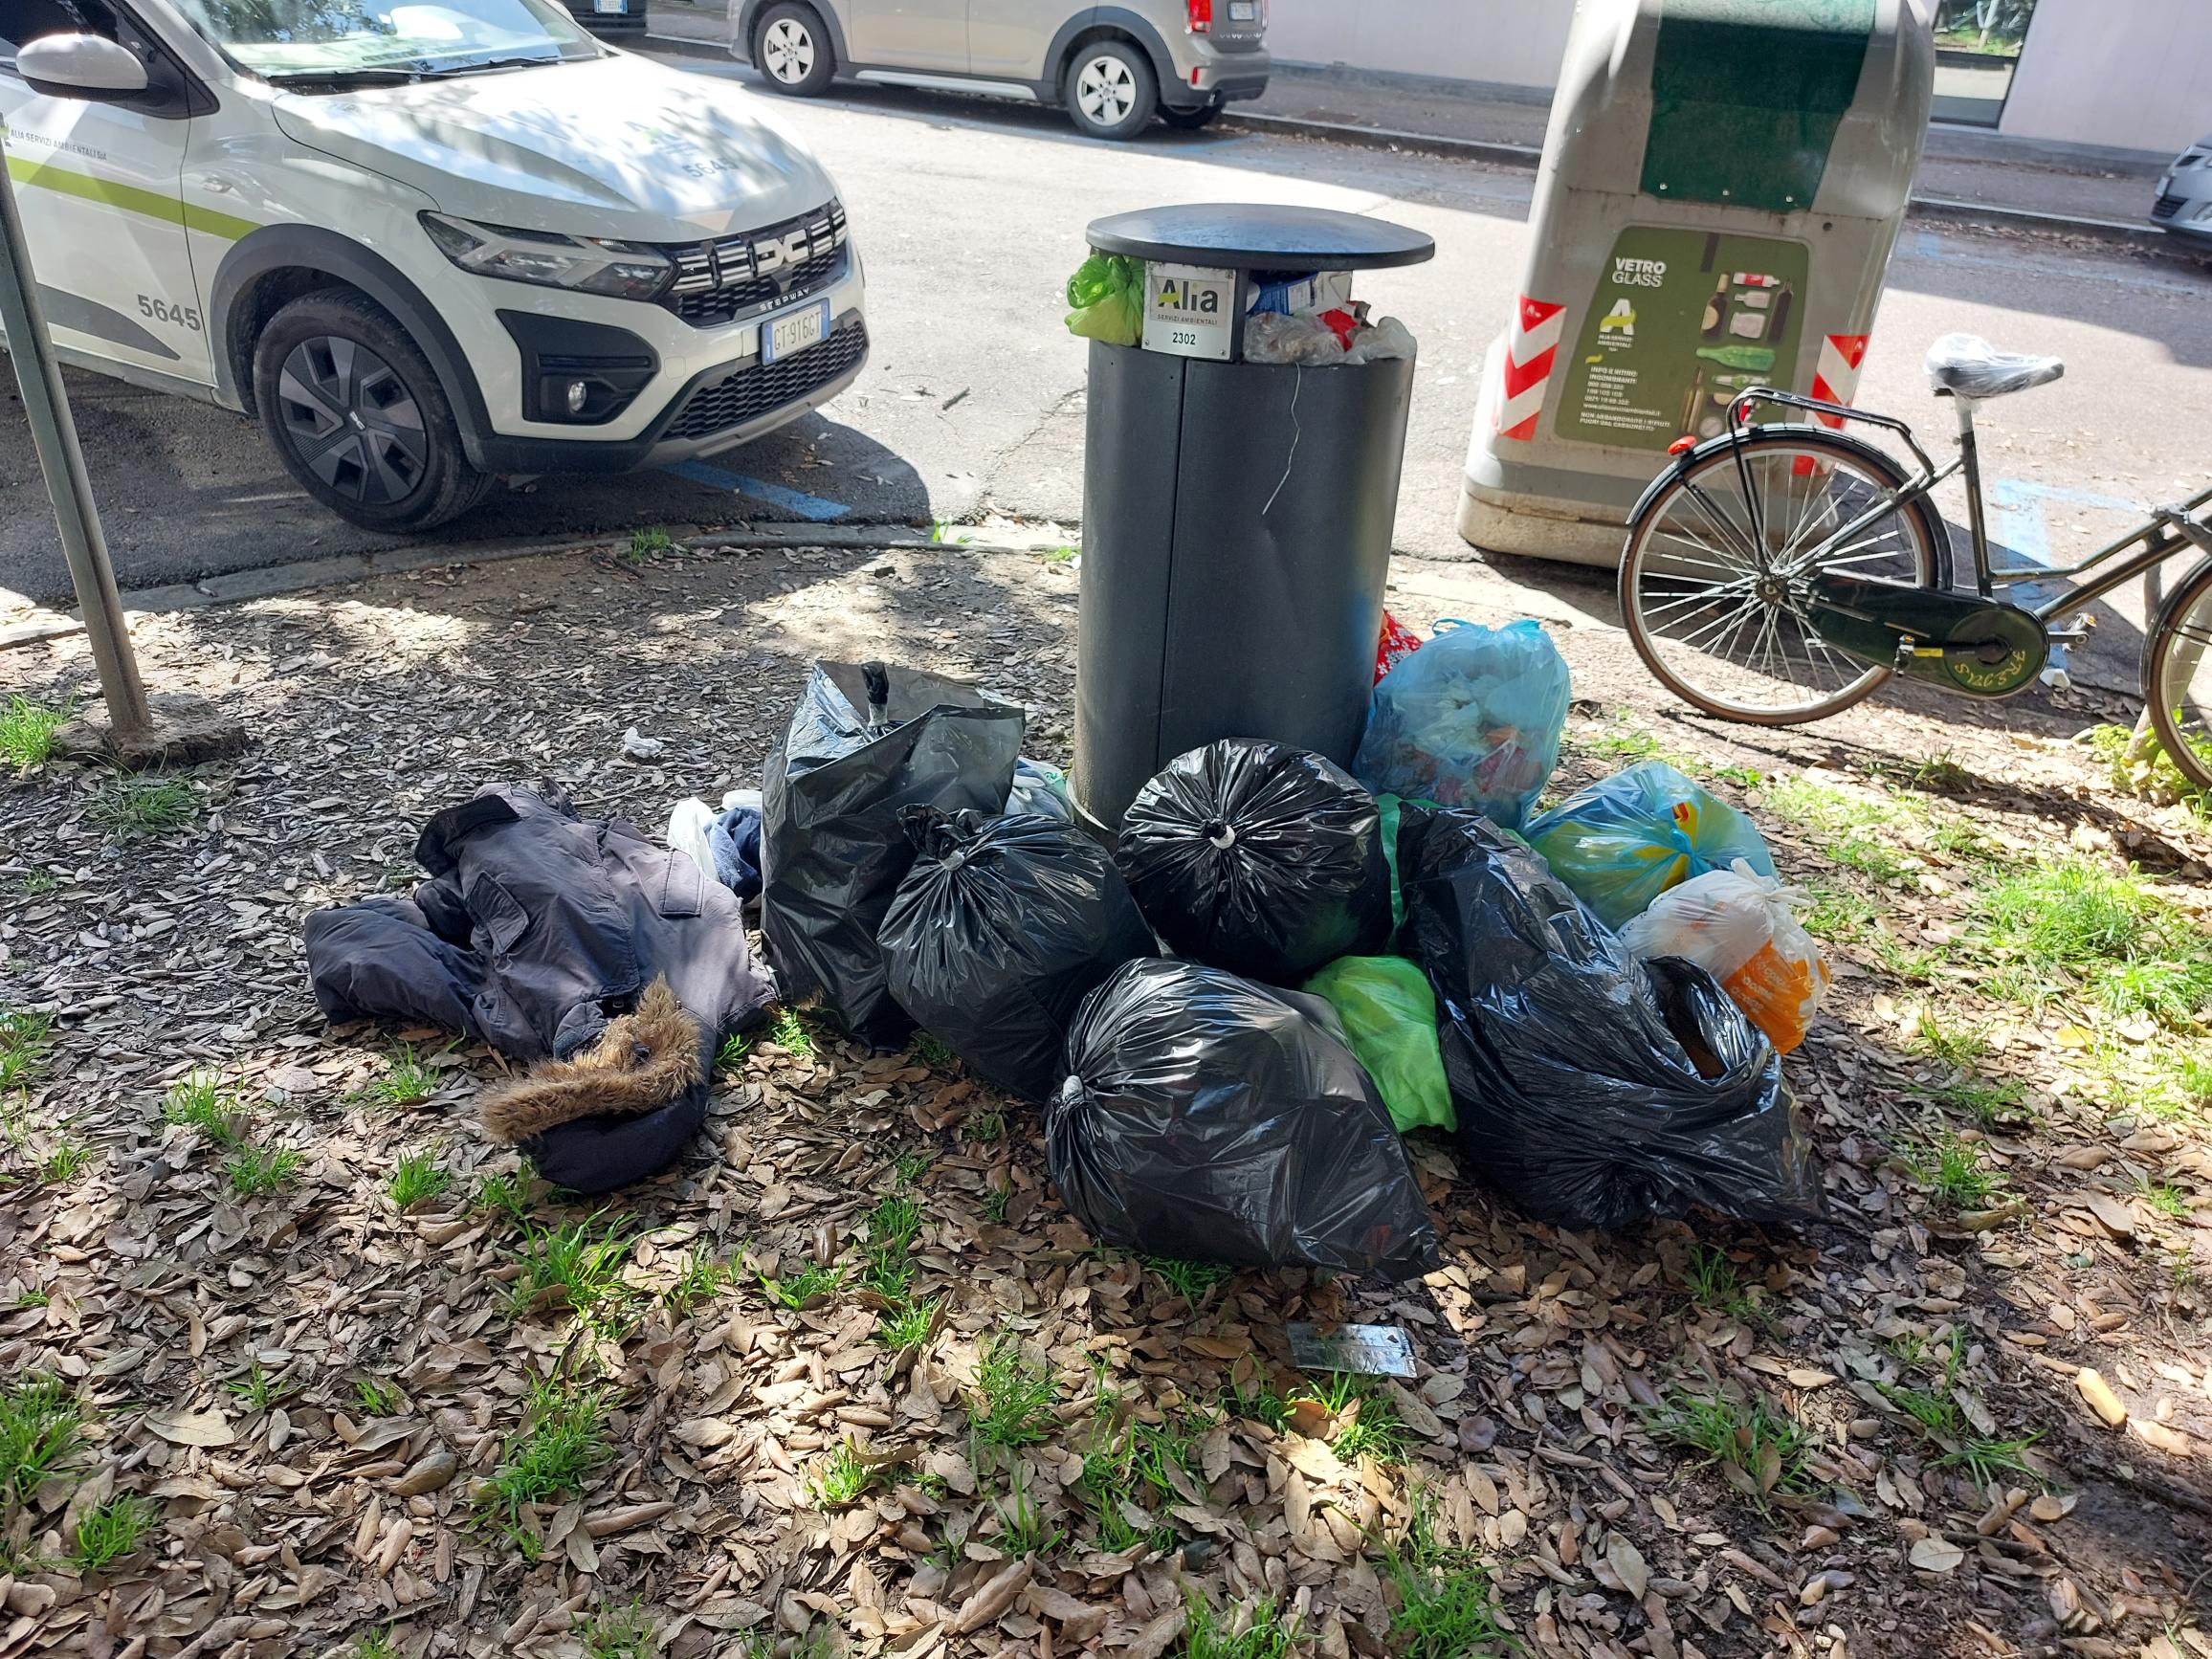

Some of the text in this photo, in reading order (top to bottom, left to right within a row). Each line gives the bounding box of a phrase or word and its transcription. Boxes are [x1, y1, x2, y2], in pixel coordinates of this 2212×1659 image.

[11, 129, 25, 140] ALIA
[25, 132, 52, 146] SERVIZI
[1615, 257, 1667, 275] VETRO
[1611, 270, 1664, 288] GLASS
[759, 287, 810, 313] STEPWAY
[1158, 278, 1218, 314] Alia
[137, 294, 201, 331] 5645
[1157, 313, 1218, 325] SERVIZI AMBIENTALI
[1172, 332, 1196, 345] 2302
